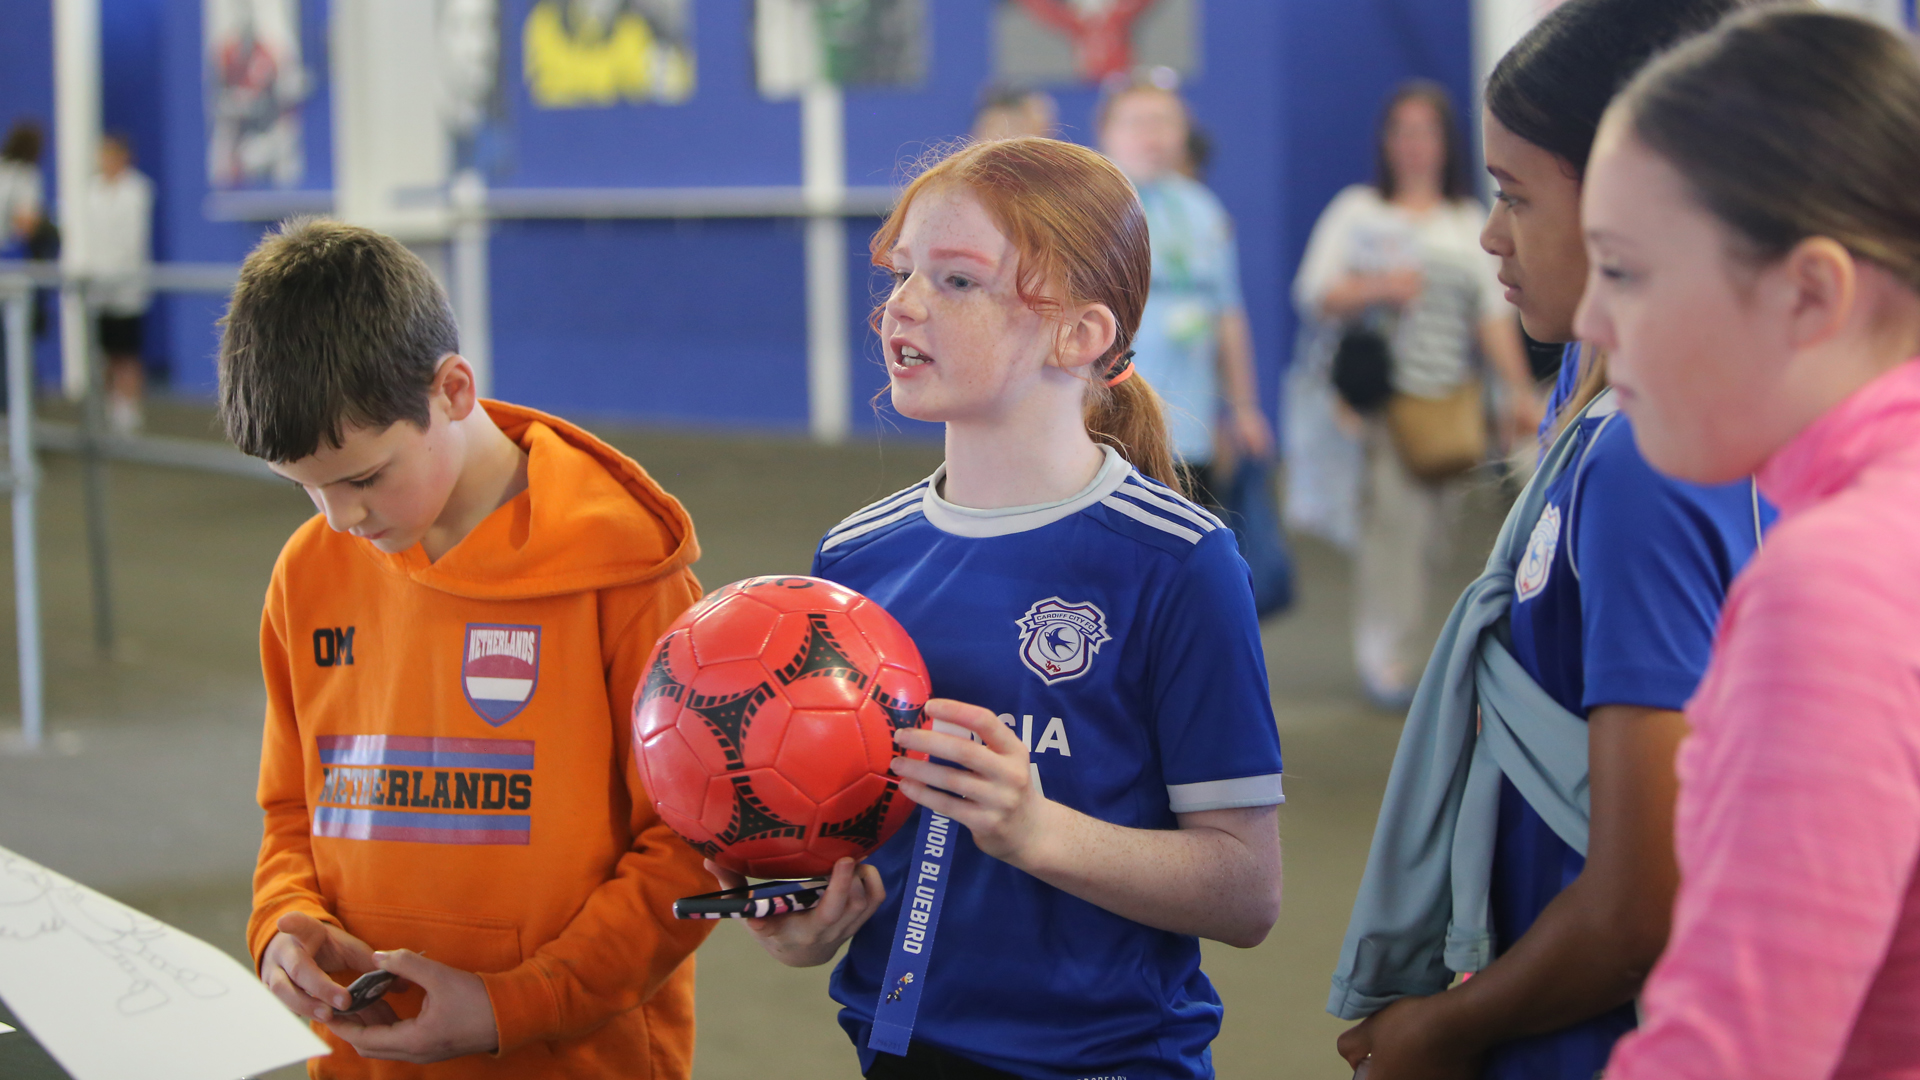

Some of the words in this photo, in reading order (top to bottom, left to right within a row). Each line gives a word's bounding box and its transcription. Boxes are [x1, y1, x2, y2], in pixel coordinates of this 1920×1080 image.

[1036, 612, 1068, 621] CARDIFF
[1068, 614, 1085, 624] CITY
[1084, 621, 1095, 630] FC
[312, 626, 356, 667] OM
[468, 629, 535, 666] NETHERLANDS
[318, 767, 532, 810] NETHERLANDS
[924, 810, 950, 858] NIOR
[903, 860, 941, 955] BLUEBIRD
